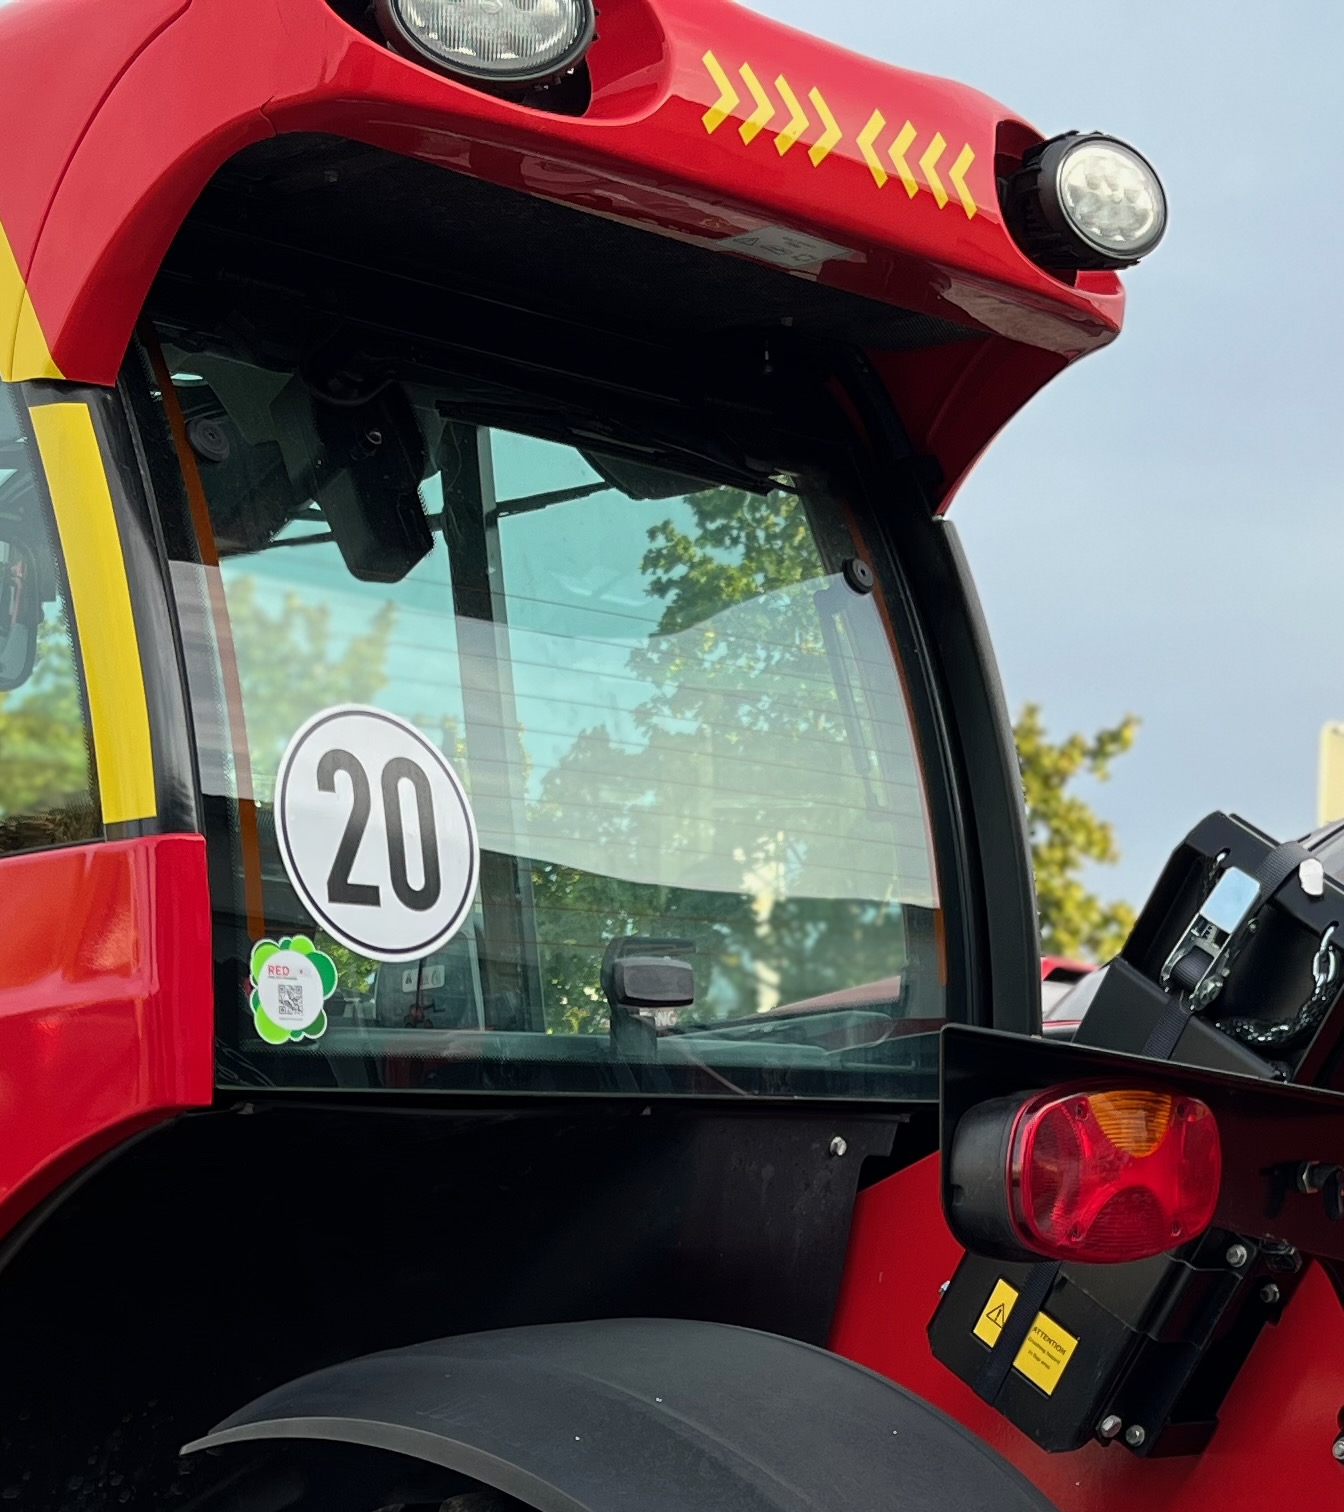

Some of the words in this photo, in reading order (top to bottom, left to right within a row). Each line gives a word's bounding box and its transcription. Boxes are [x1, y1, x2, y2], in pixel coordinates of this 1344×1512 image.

[316, 748, 442, 912] 20
[267, 965, 290, 976] RED
[1032, 1326, 1067, 1356] ATTENTION
